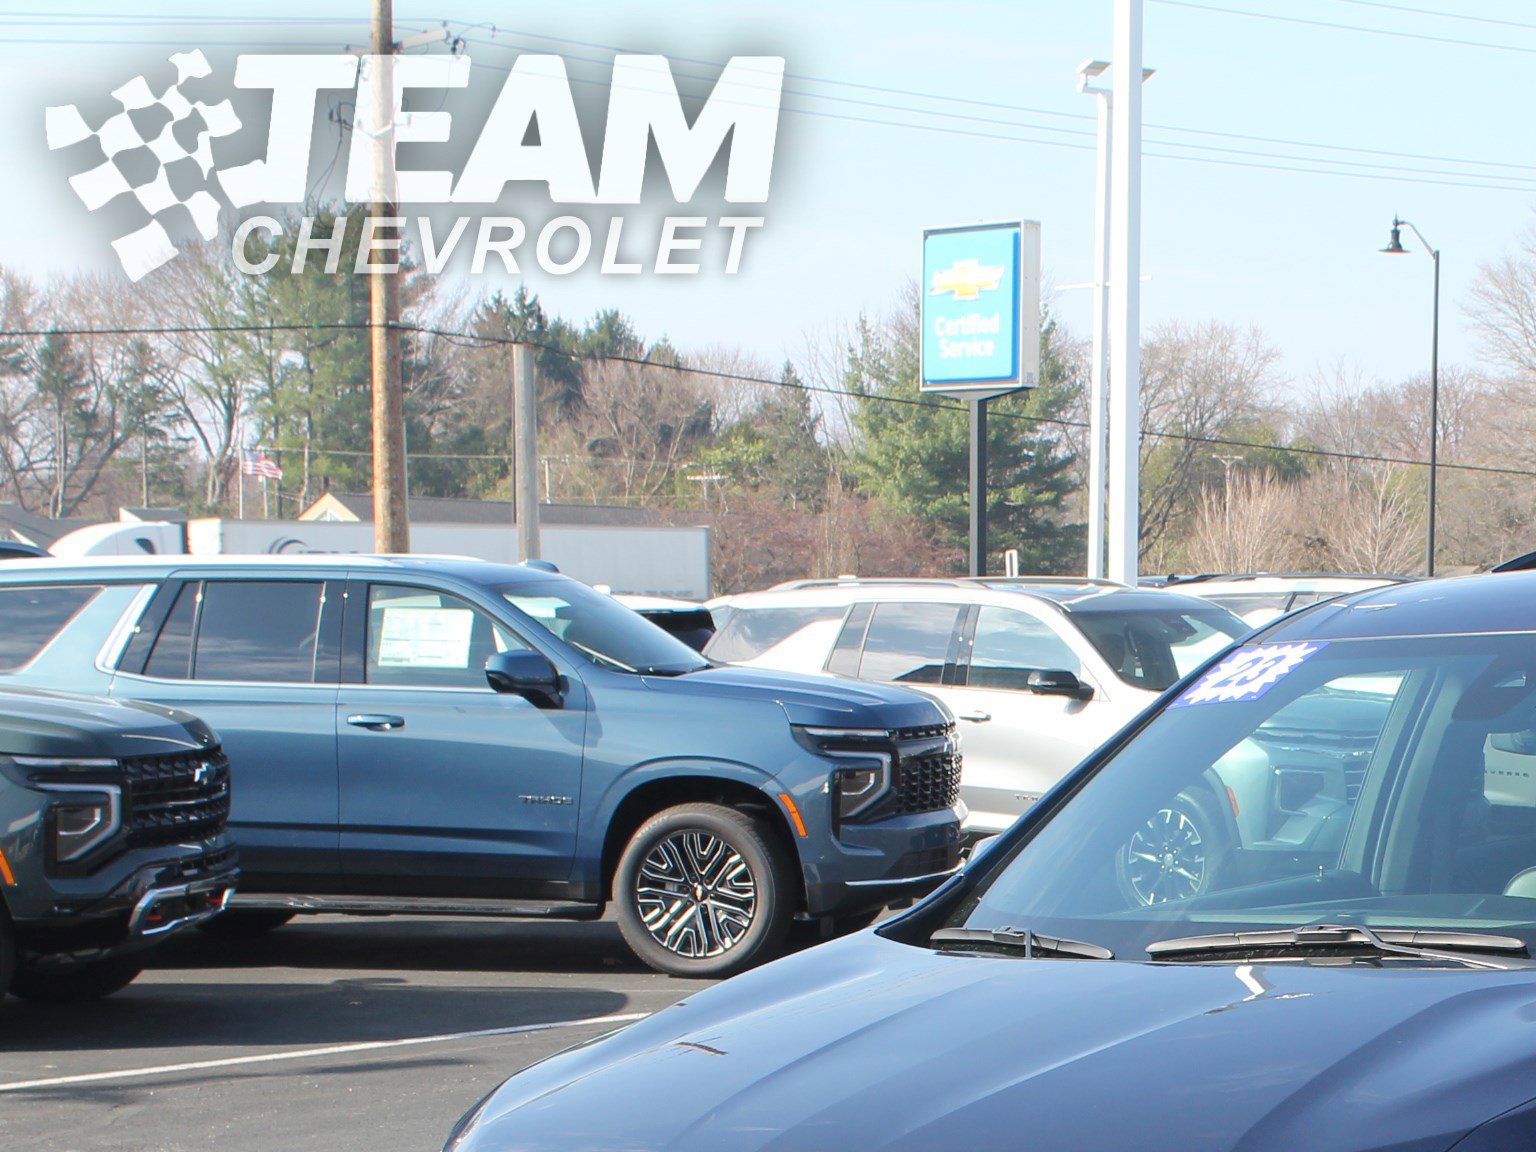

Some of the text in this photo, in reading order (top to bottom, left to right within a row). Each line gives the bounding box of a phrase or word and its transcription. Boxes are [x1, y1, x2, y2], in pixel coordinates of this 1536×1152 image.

[935, 312, 999, 335] Certified
[940, 337, 994, 357] Service
[1210, 654, 1288, 688] 23
